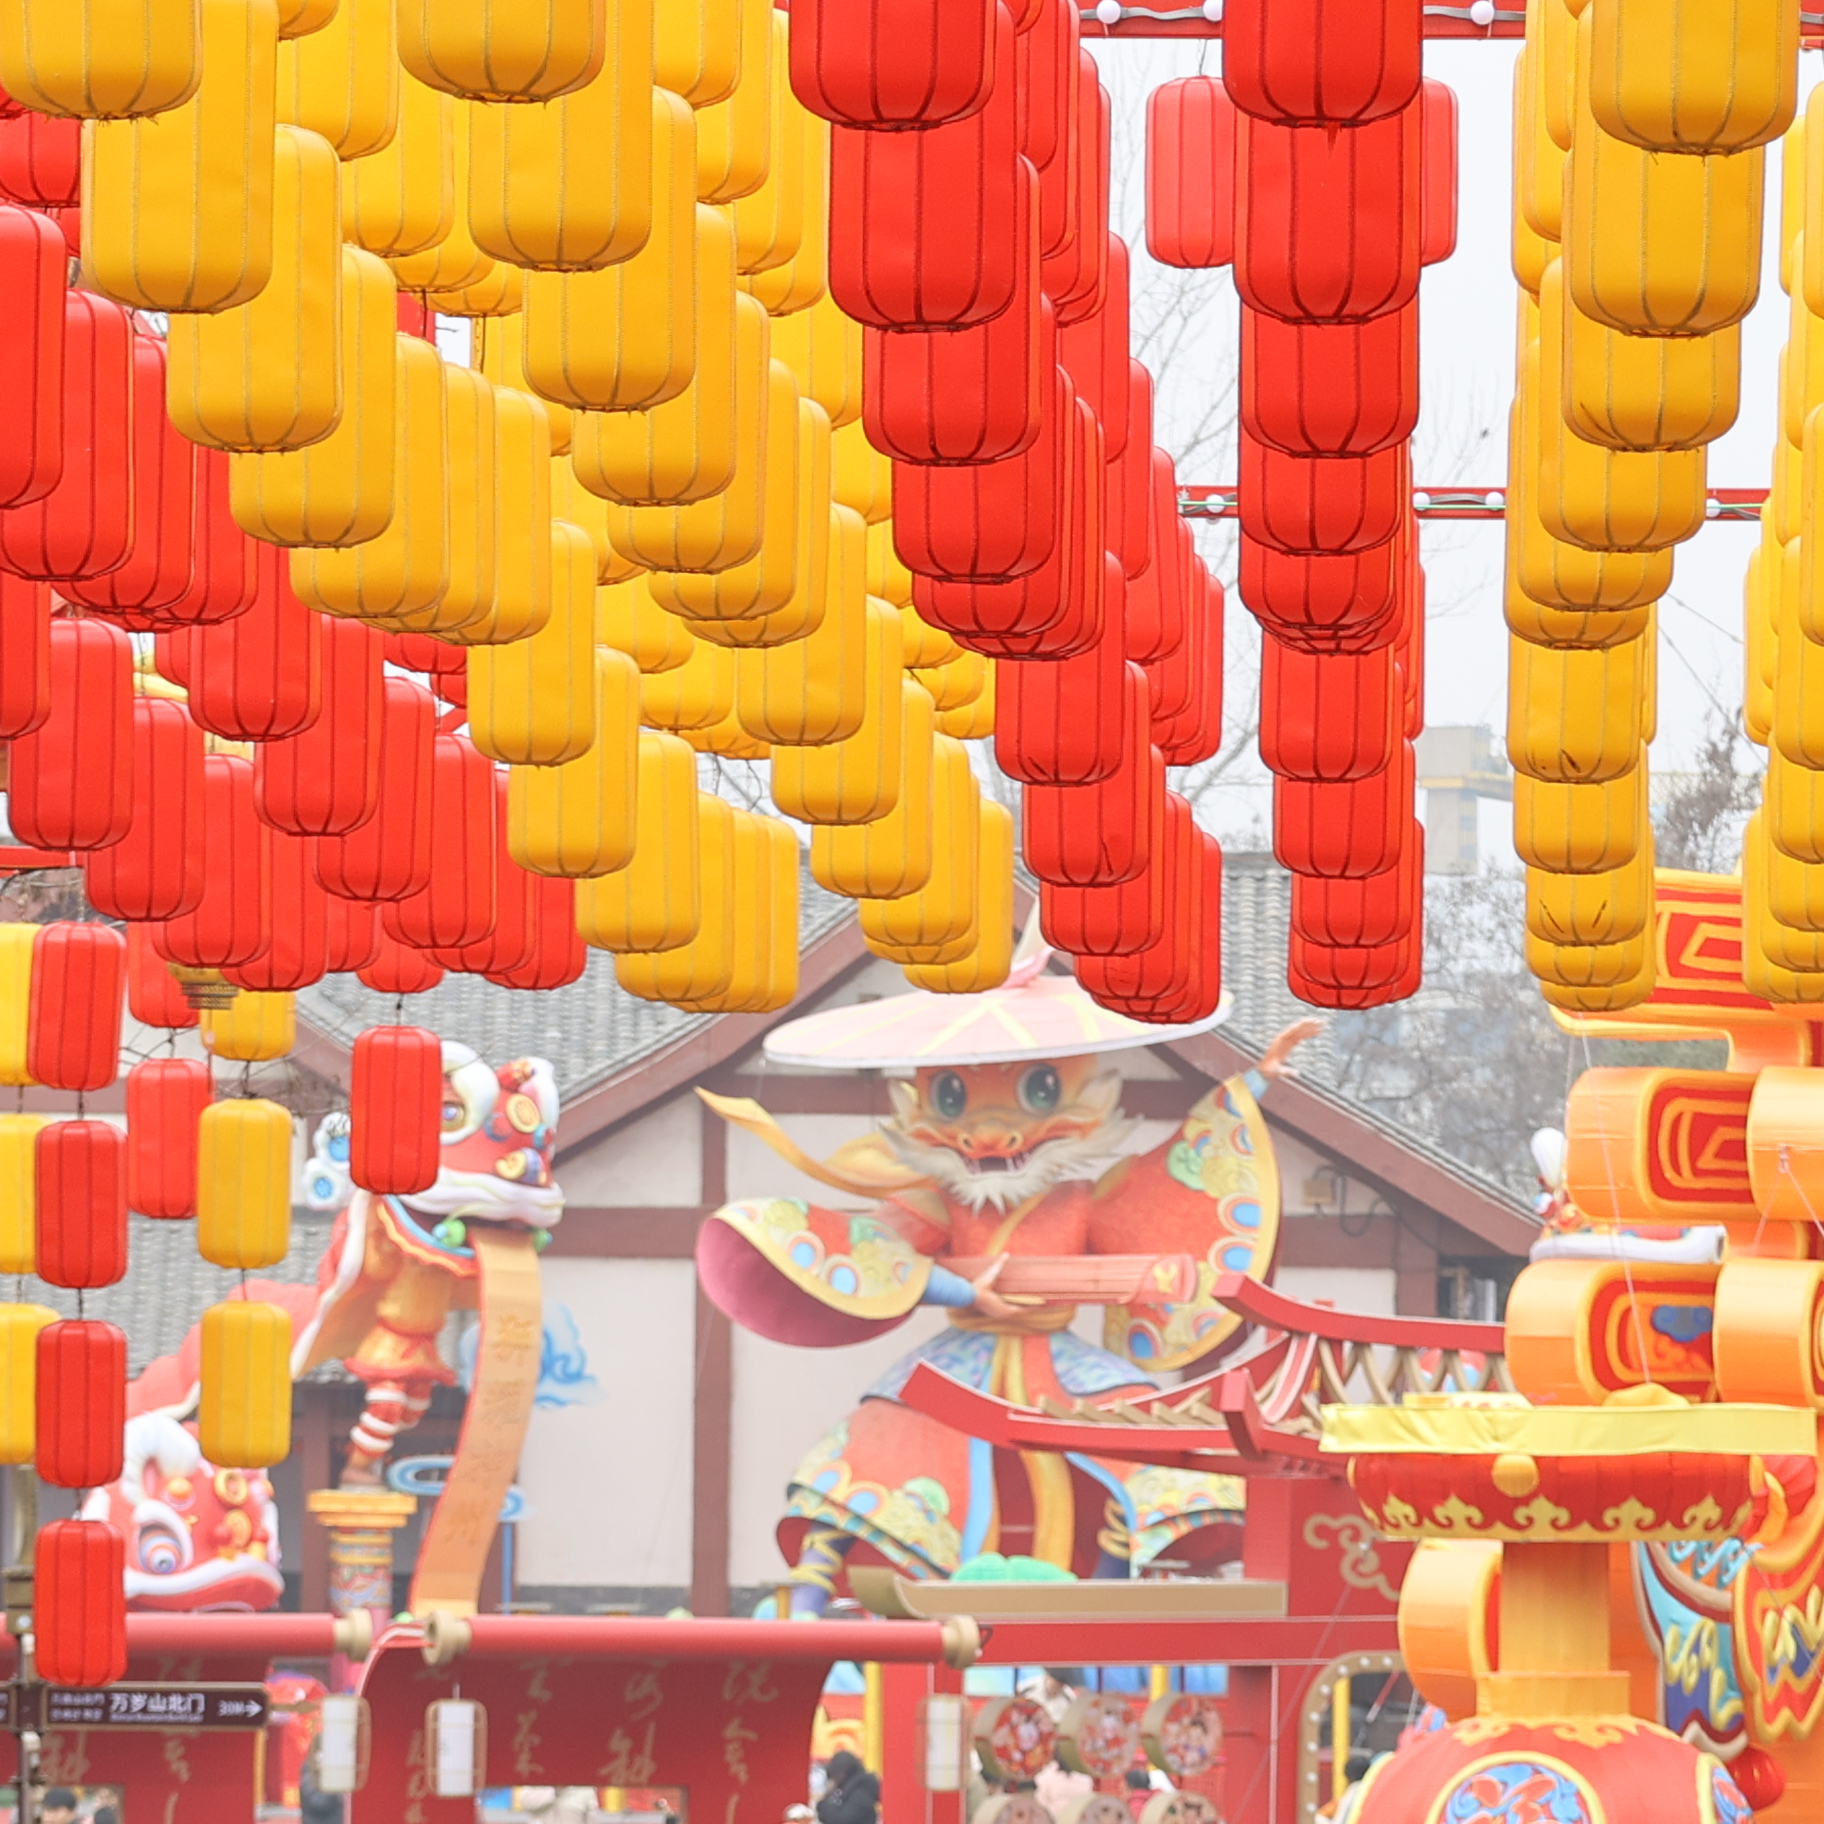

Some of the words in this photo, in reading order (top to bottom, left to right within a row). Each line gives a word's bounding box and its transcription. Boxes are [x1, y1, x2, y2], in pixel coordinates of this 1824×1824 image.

[109, 1693, 205, 1714] 万岁山北门
